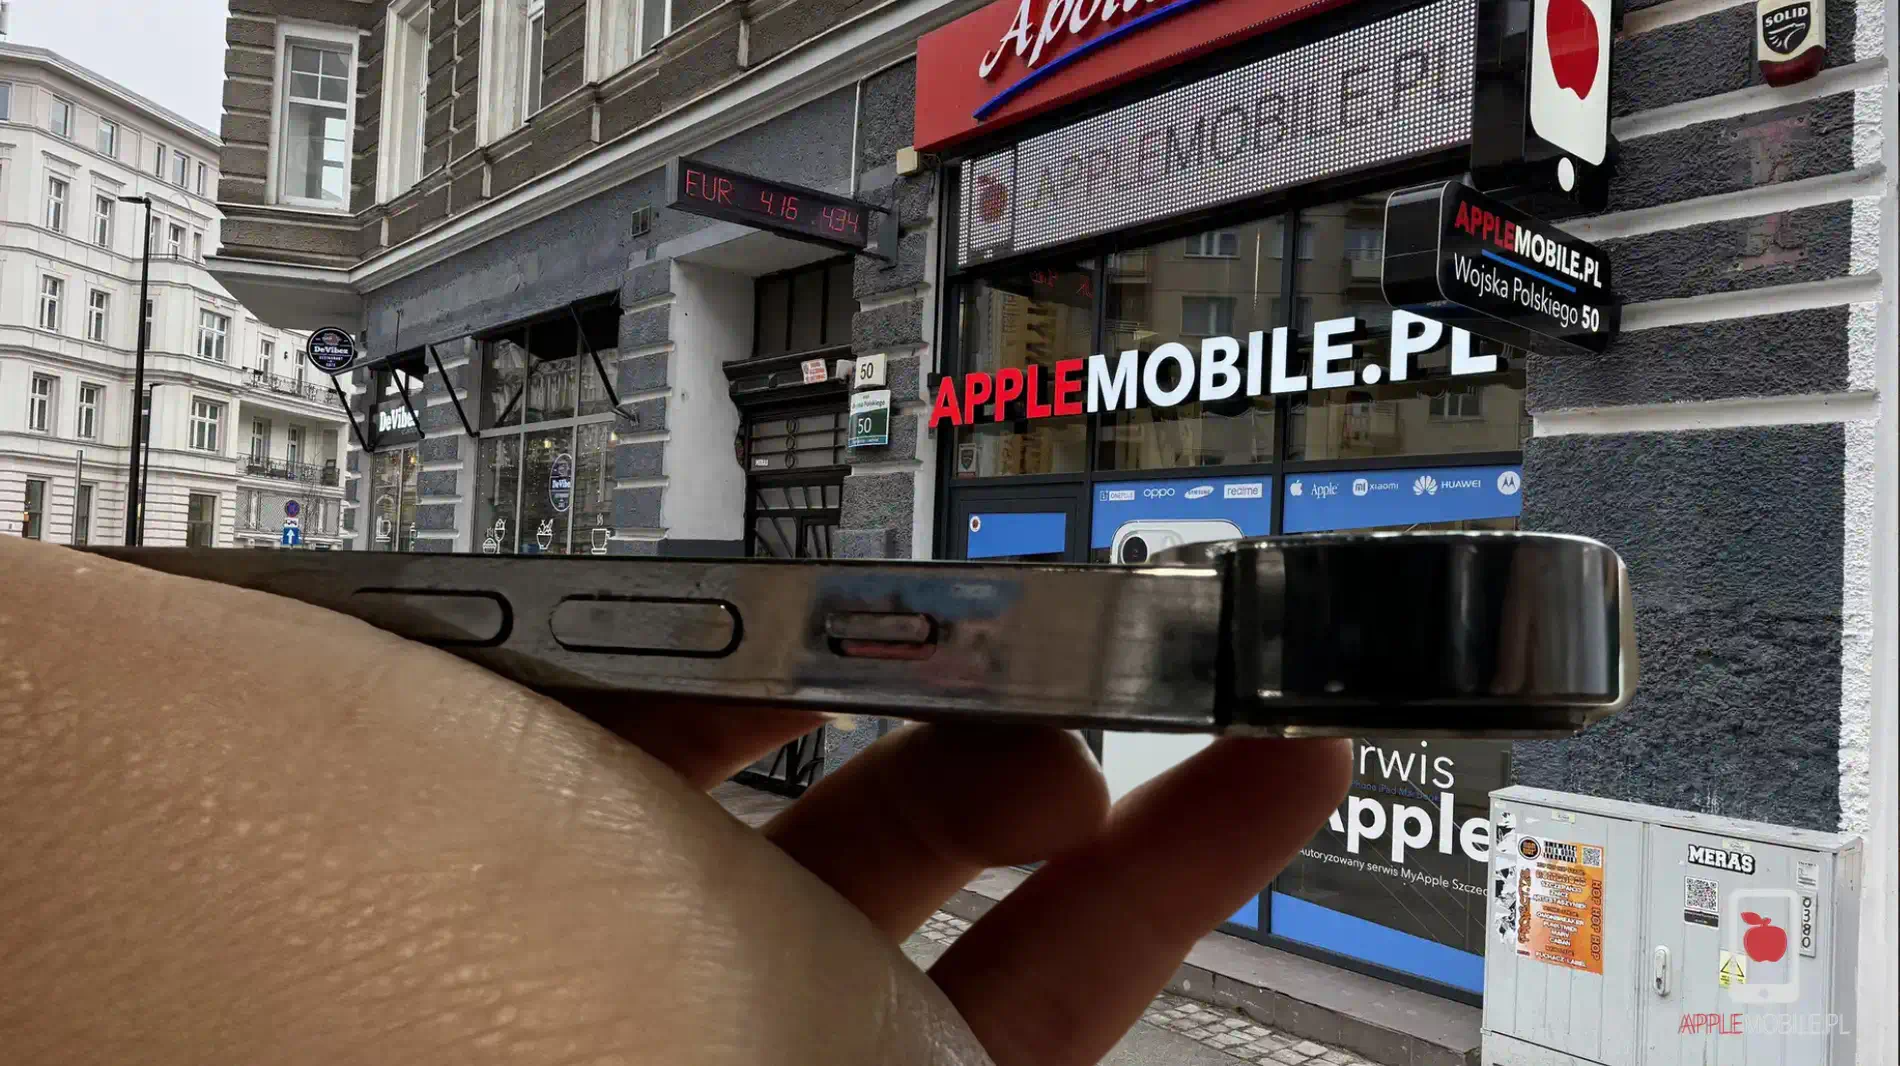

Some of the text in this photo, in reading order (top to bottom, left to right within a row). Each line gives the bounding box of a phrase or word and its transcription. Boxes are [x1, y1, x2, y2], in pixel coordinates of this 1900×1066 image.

[978, 0, 1156, 78] Apo
[1765, 7, 1808, 28] SOLID
[686, 169, 733, 205] EUR
[760, 190, 799, 221] 4.16
[1454, 200, 1602, 288] APPLEMOBILE.PL
[1454, 252, 1600, 332] Wojska Polskiego 50
[860, 362, 874, 380] 50
[928, 309, 1497, 428] APPLEMOBILE.PL
[857, 417, 872, 434] 50
[1143, 488, 1175, 499] oppo
[1227, 485, 1259, 495] realme
[1311, 482, 1338, 499] Apple
[1369, 482, 1400, 492] xiaomi
[1441, 479, 1481, 489] HUAWEI
[1360, 740, 1455, 789] rwis
[1367, 859, 1399, 877] serwis
[1400, 867, 1450, 888] MyApple
[1452, 878, 1489, 897] Szczec
[1689, 845, 1754, 875] MERAS
[1591, 880, 1602, 960] HOP HOP HOP
